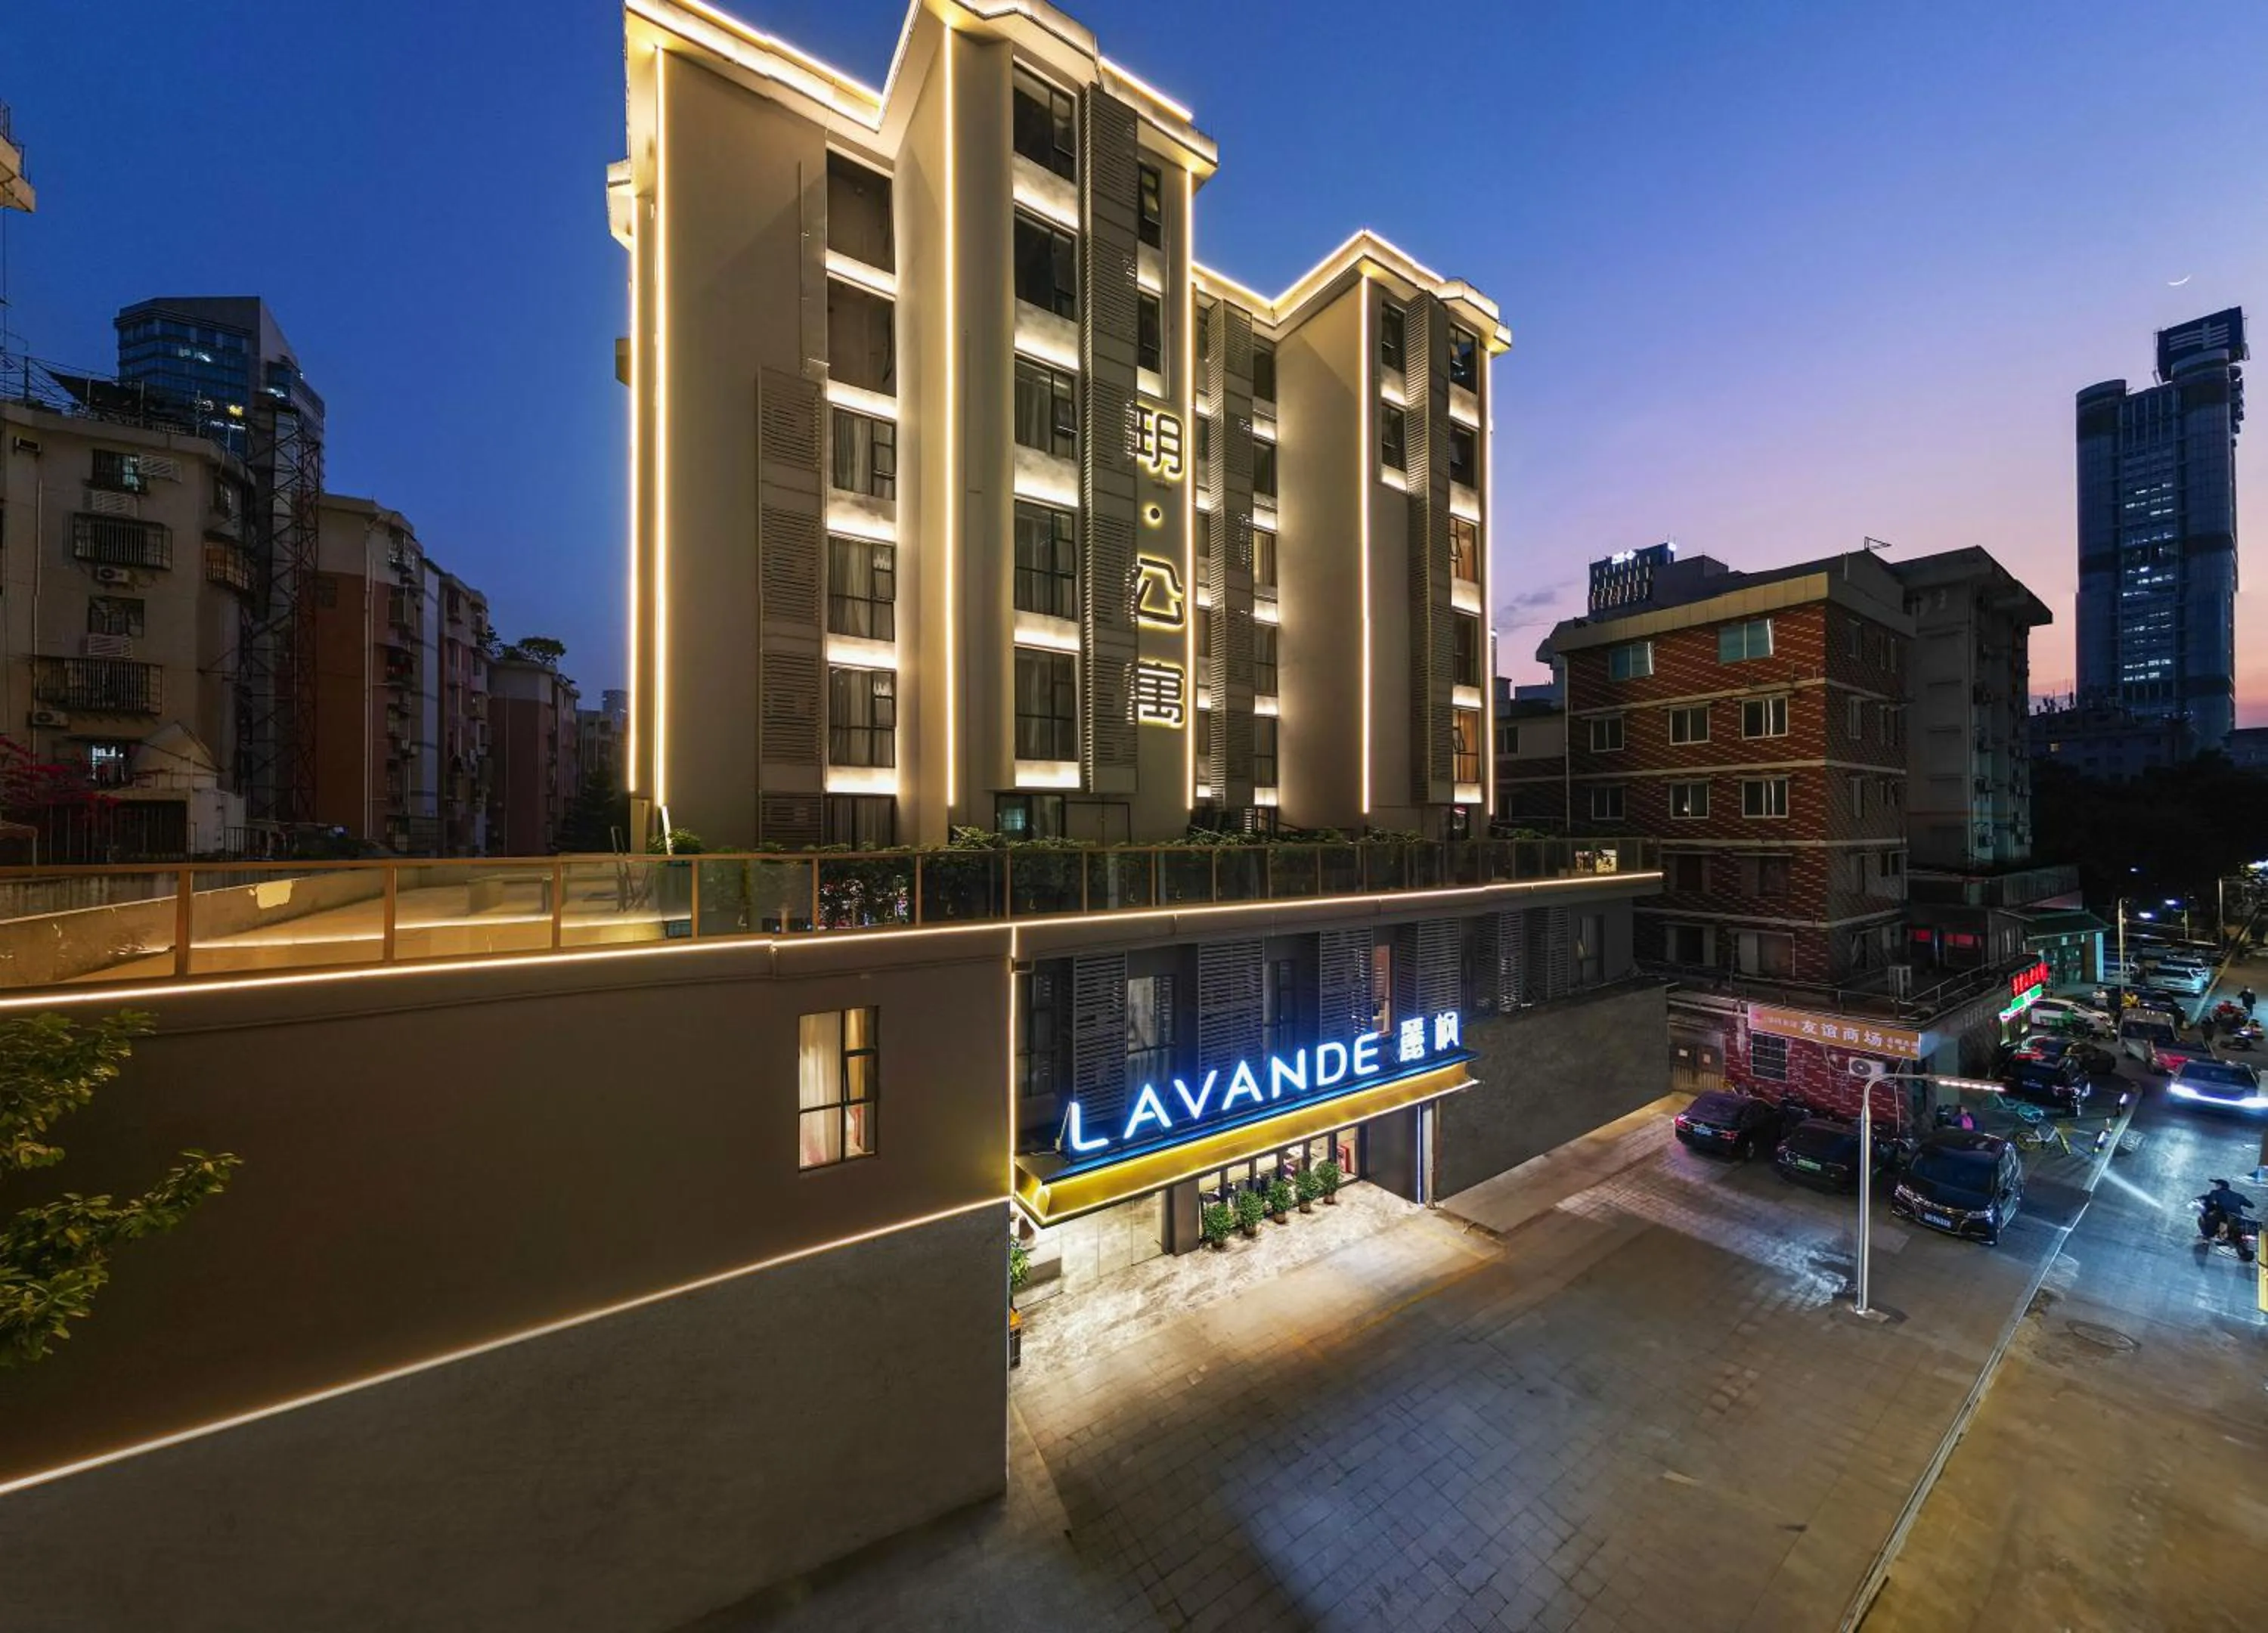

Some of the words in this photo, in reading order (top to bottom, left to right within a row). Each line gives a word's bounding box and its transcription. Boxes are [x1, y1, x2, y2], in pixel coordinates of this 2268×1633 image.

[1801, 1019, 1883, 1048] 友谊商场
[1070, 1032, 1380, 1151] LAVANDE
